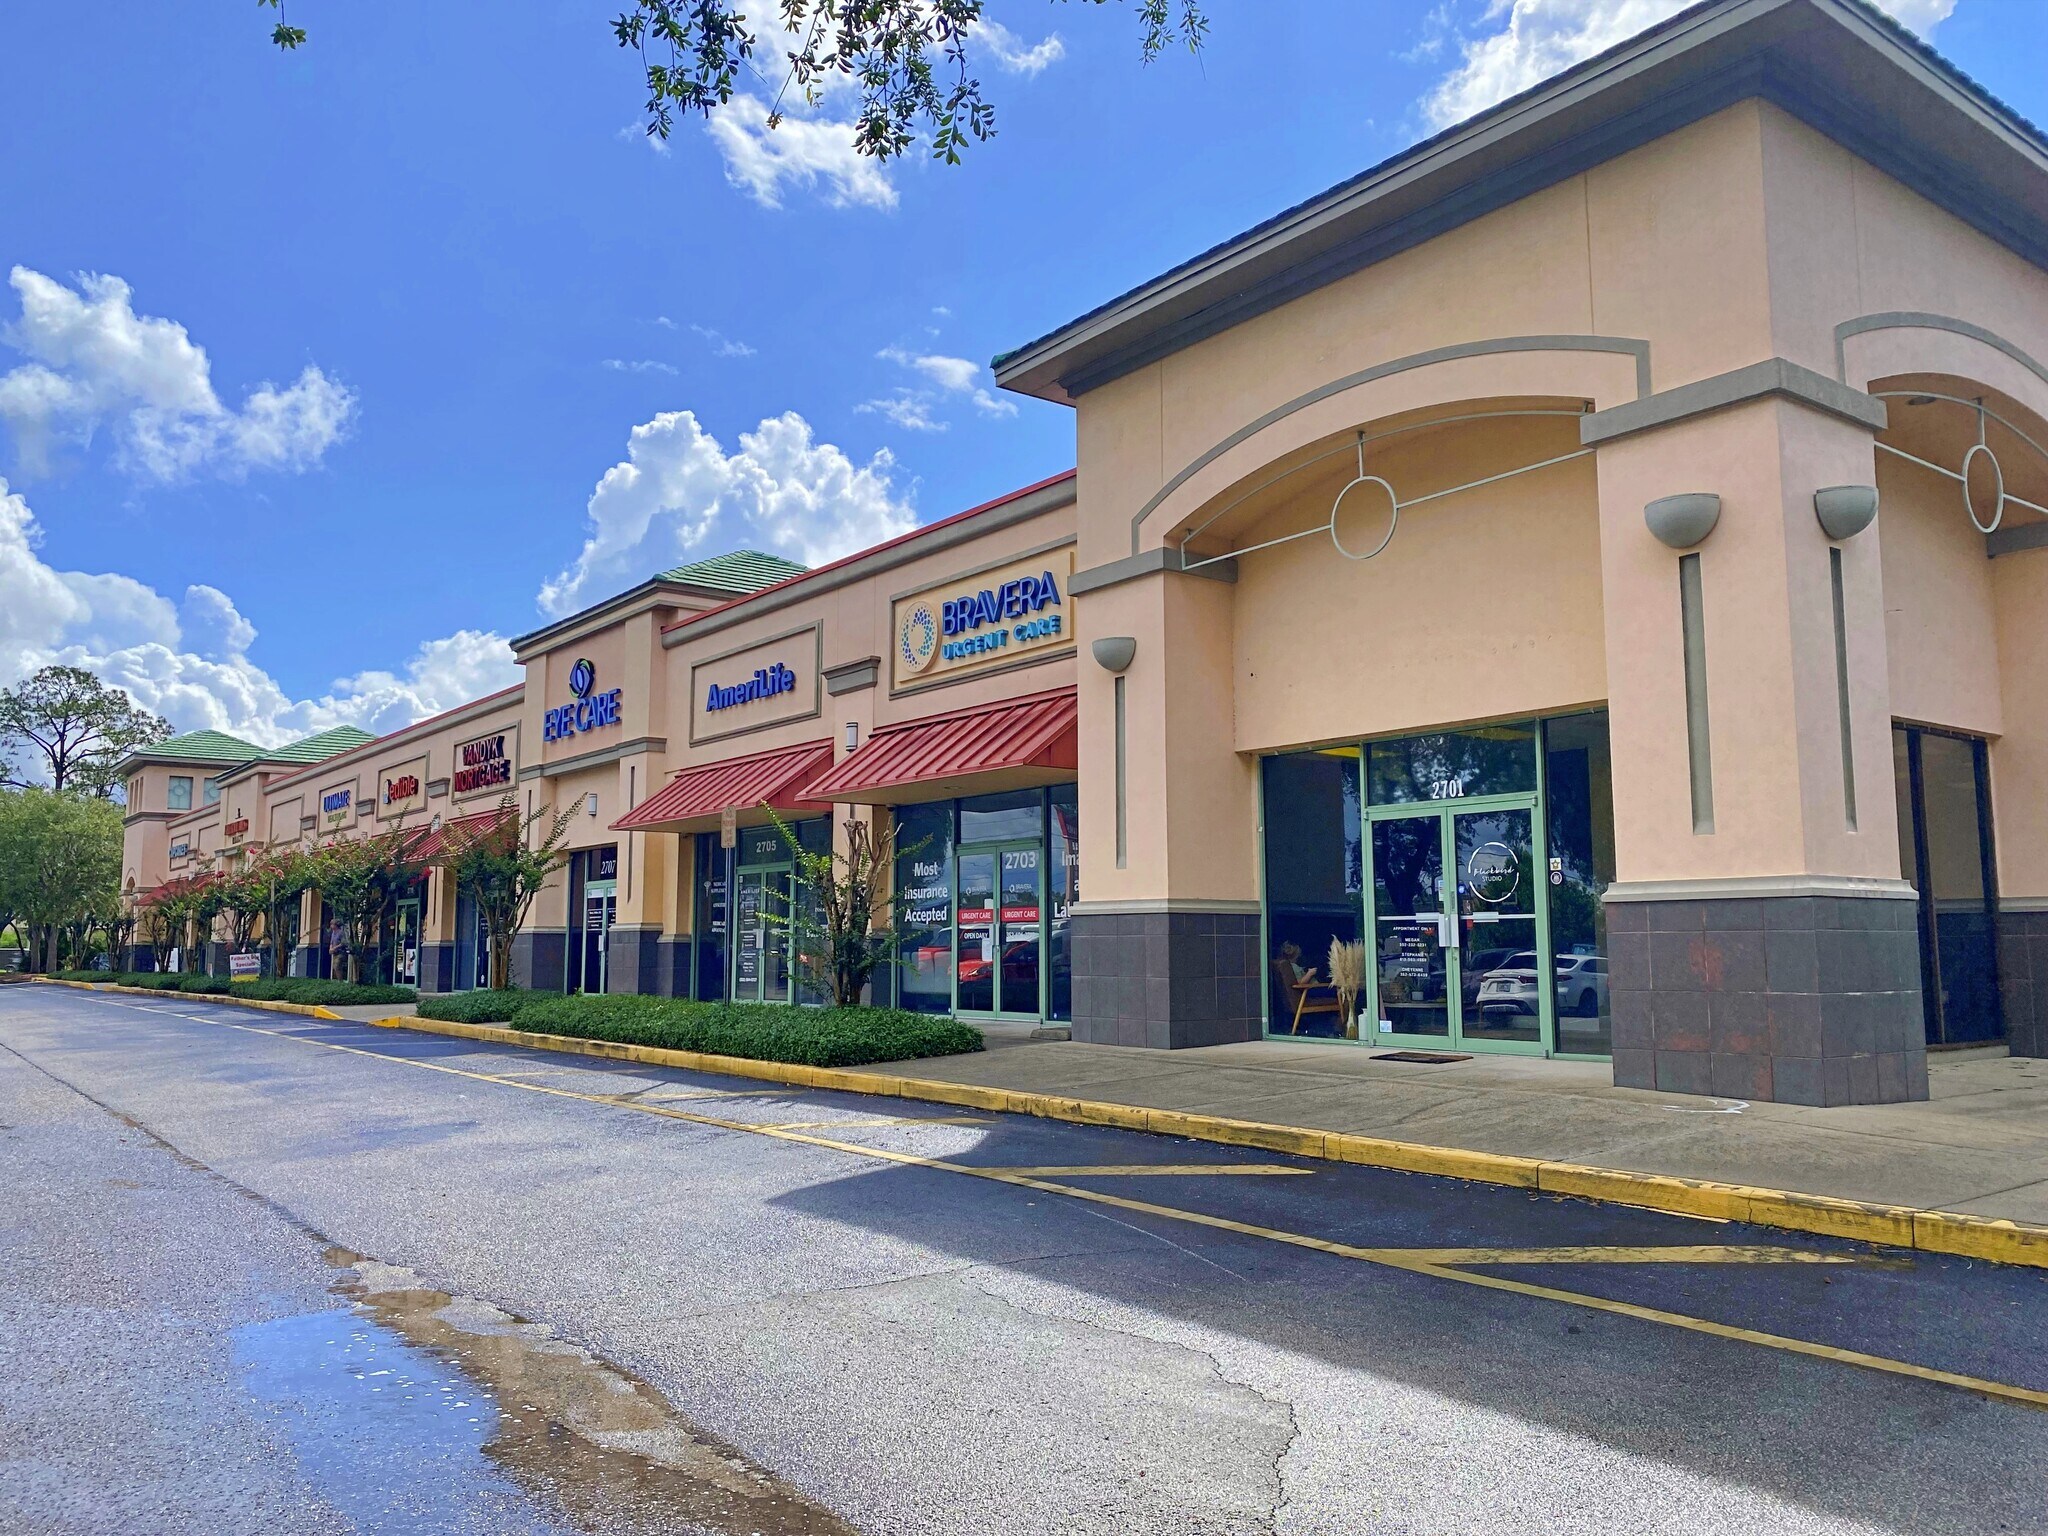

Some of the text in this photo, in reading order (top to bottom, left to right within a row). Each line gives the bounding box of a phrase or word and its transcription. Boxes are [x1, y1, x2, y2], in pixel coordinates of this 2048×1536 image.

[943, 571, 1061, 635] BRAVERA
[942, 615, 1061, 660] URGENT CARE
[706, 663, 795, 712] AmeriLife
[543, 688, 621, 741] EYE CARE
[455, 760, 511, 792] MORTGAGE
[389, 775, 419, 801] edible
[1432, 780, 1464, 800] 2701
[756, 840, 777, 853] 2705
[600, 860, 616, 874] 2707
[914, 861, 938, 877] Most
[1005, 851, 1036, 870] 2703
[904, 905, 947, 925] Accepted
[961, 911, 991, 920] URGENT CARE
[1004, 910, 1036, 919] URGENT CARE
[963, 932, 976, 940] OPEN
